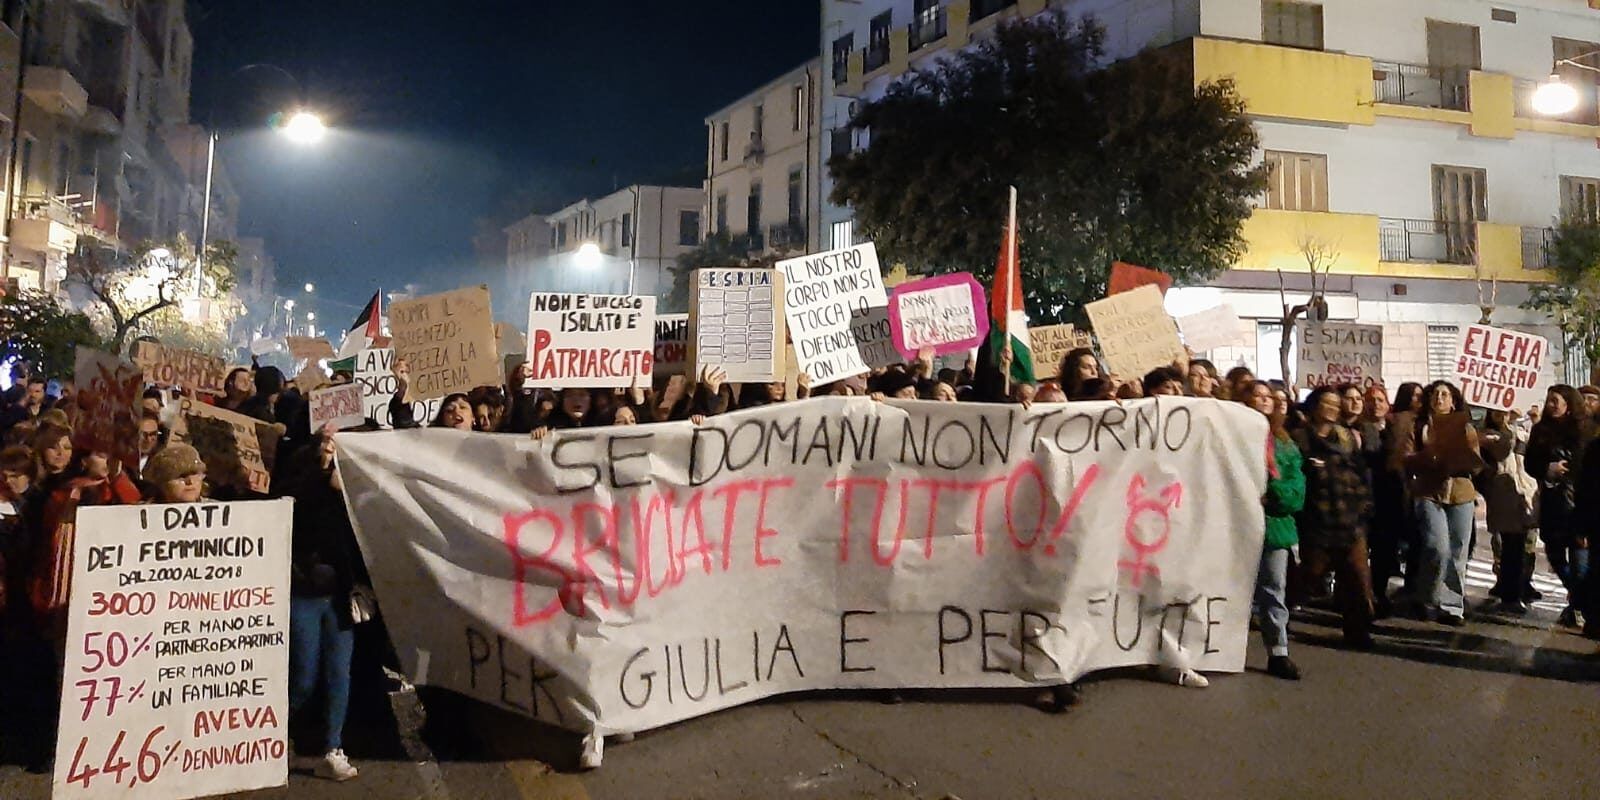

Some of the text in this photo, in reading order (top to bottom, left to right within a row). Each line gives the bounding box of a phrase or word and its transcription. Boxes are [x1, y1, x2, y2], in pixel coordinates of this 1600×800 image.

[785, 248, 862, 284] IL NOSTRO
[786, 268, 875, 308] CORPO NON SI
[561, 311, 621, 332] ISOLATO
[792, 302, 846, 333] TOCCA
[848, 295, 870, 318] LO
[460, 341, 477, 362] LA
[800, 318, 892, 359] DIFENDEREMO
[1321, 328, 1381, 346] STATO
[1464, 327, 1541, 372] ELENA,
[355, 351, 375, 373] LA
[837, 352, 857, 373] LA
[1302, 348, 1379, 367] IL VOSTRO
[1457, 355, 1537, 389] BRUCEREMO
[417, 365, 471, 394] CATENA
[1460, 377, 1515, 408] TUTTO
[551, 396, 1192, 494] SE DOMANI NON TORNO
[141, 505, 231, 530] I DATI
[88, 537, 264, 572] DEI FEMMINICIDI
[503, 476, 796, 628] BRUCIATE
[119, 565, 242, 586] DAL 2000 AL 2018
[88, 587, 276, 616] 3000 DONNE UCCISE
[163, 614, 275, 636] PER MANO DEL
[82, 631, 154, 673] 50%
[155, 637, 210, 658] PARTNER
[237, 631, 284, 650] PARTNER
[158, 658, 254, 683] PER MANO DI
[466, 627, 563, 722] PER
[619, 625, 804, 710] GIULIA
[840, 610, 876, 673] E
[938, 604, 1062, 675] PER
[76, 676, 146, 722] 77%
[151, 677, 268, 709] UN FAMILIARE
[194, 705, 279, 738] AVEVA
[182, 738, 285, 773] DENUNCIATO
